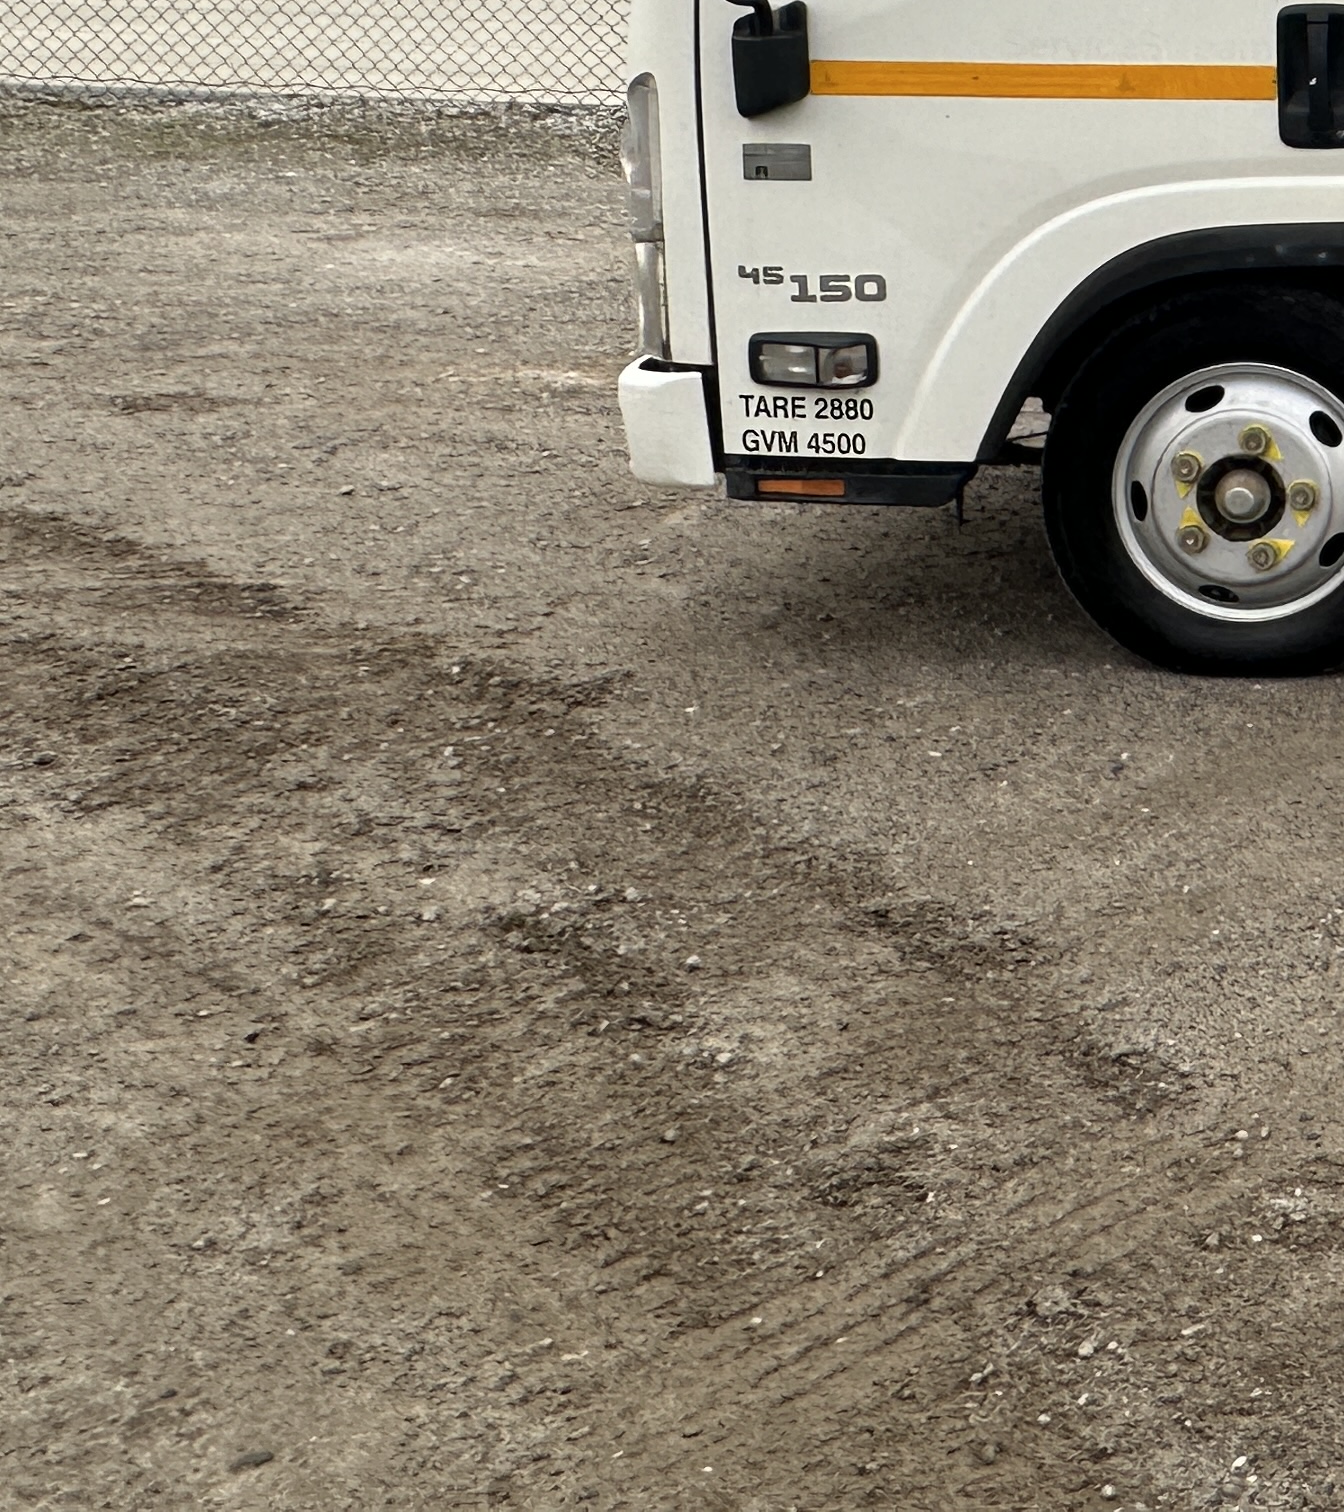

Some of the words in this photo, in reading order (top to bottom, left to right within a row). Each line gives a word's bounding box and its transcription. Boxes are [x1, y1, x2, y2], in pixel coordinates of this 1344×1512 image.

[738, 265, 784, 285] 45
[790, 274, 887, 302] 150
[739, 395, 806, 419] TARE
[814, 397, 874, 420] 2880
[742, 429, 798, 452] GVM
[807, 433, 866, 454] 4500
